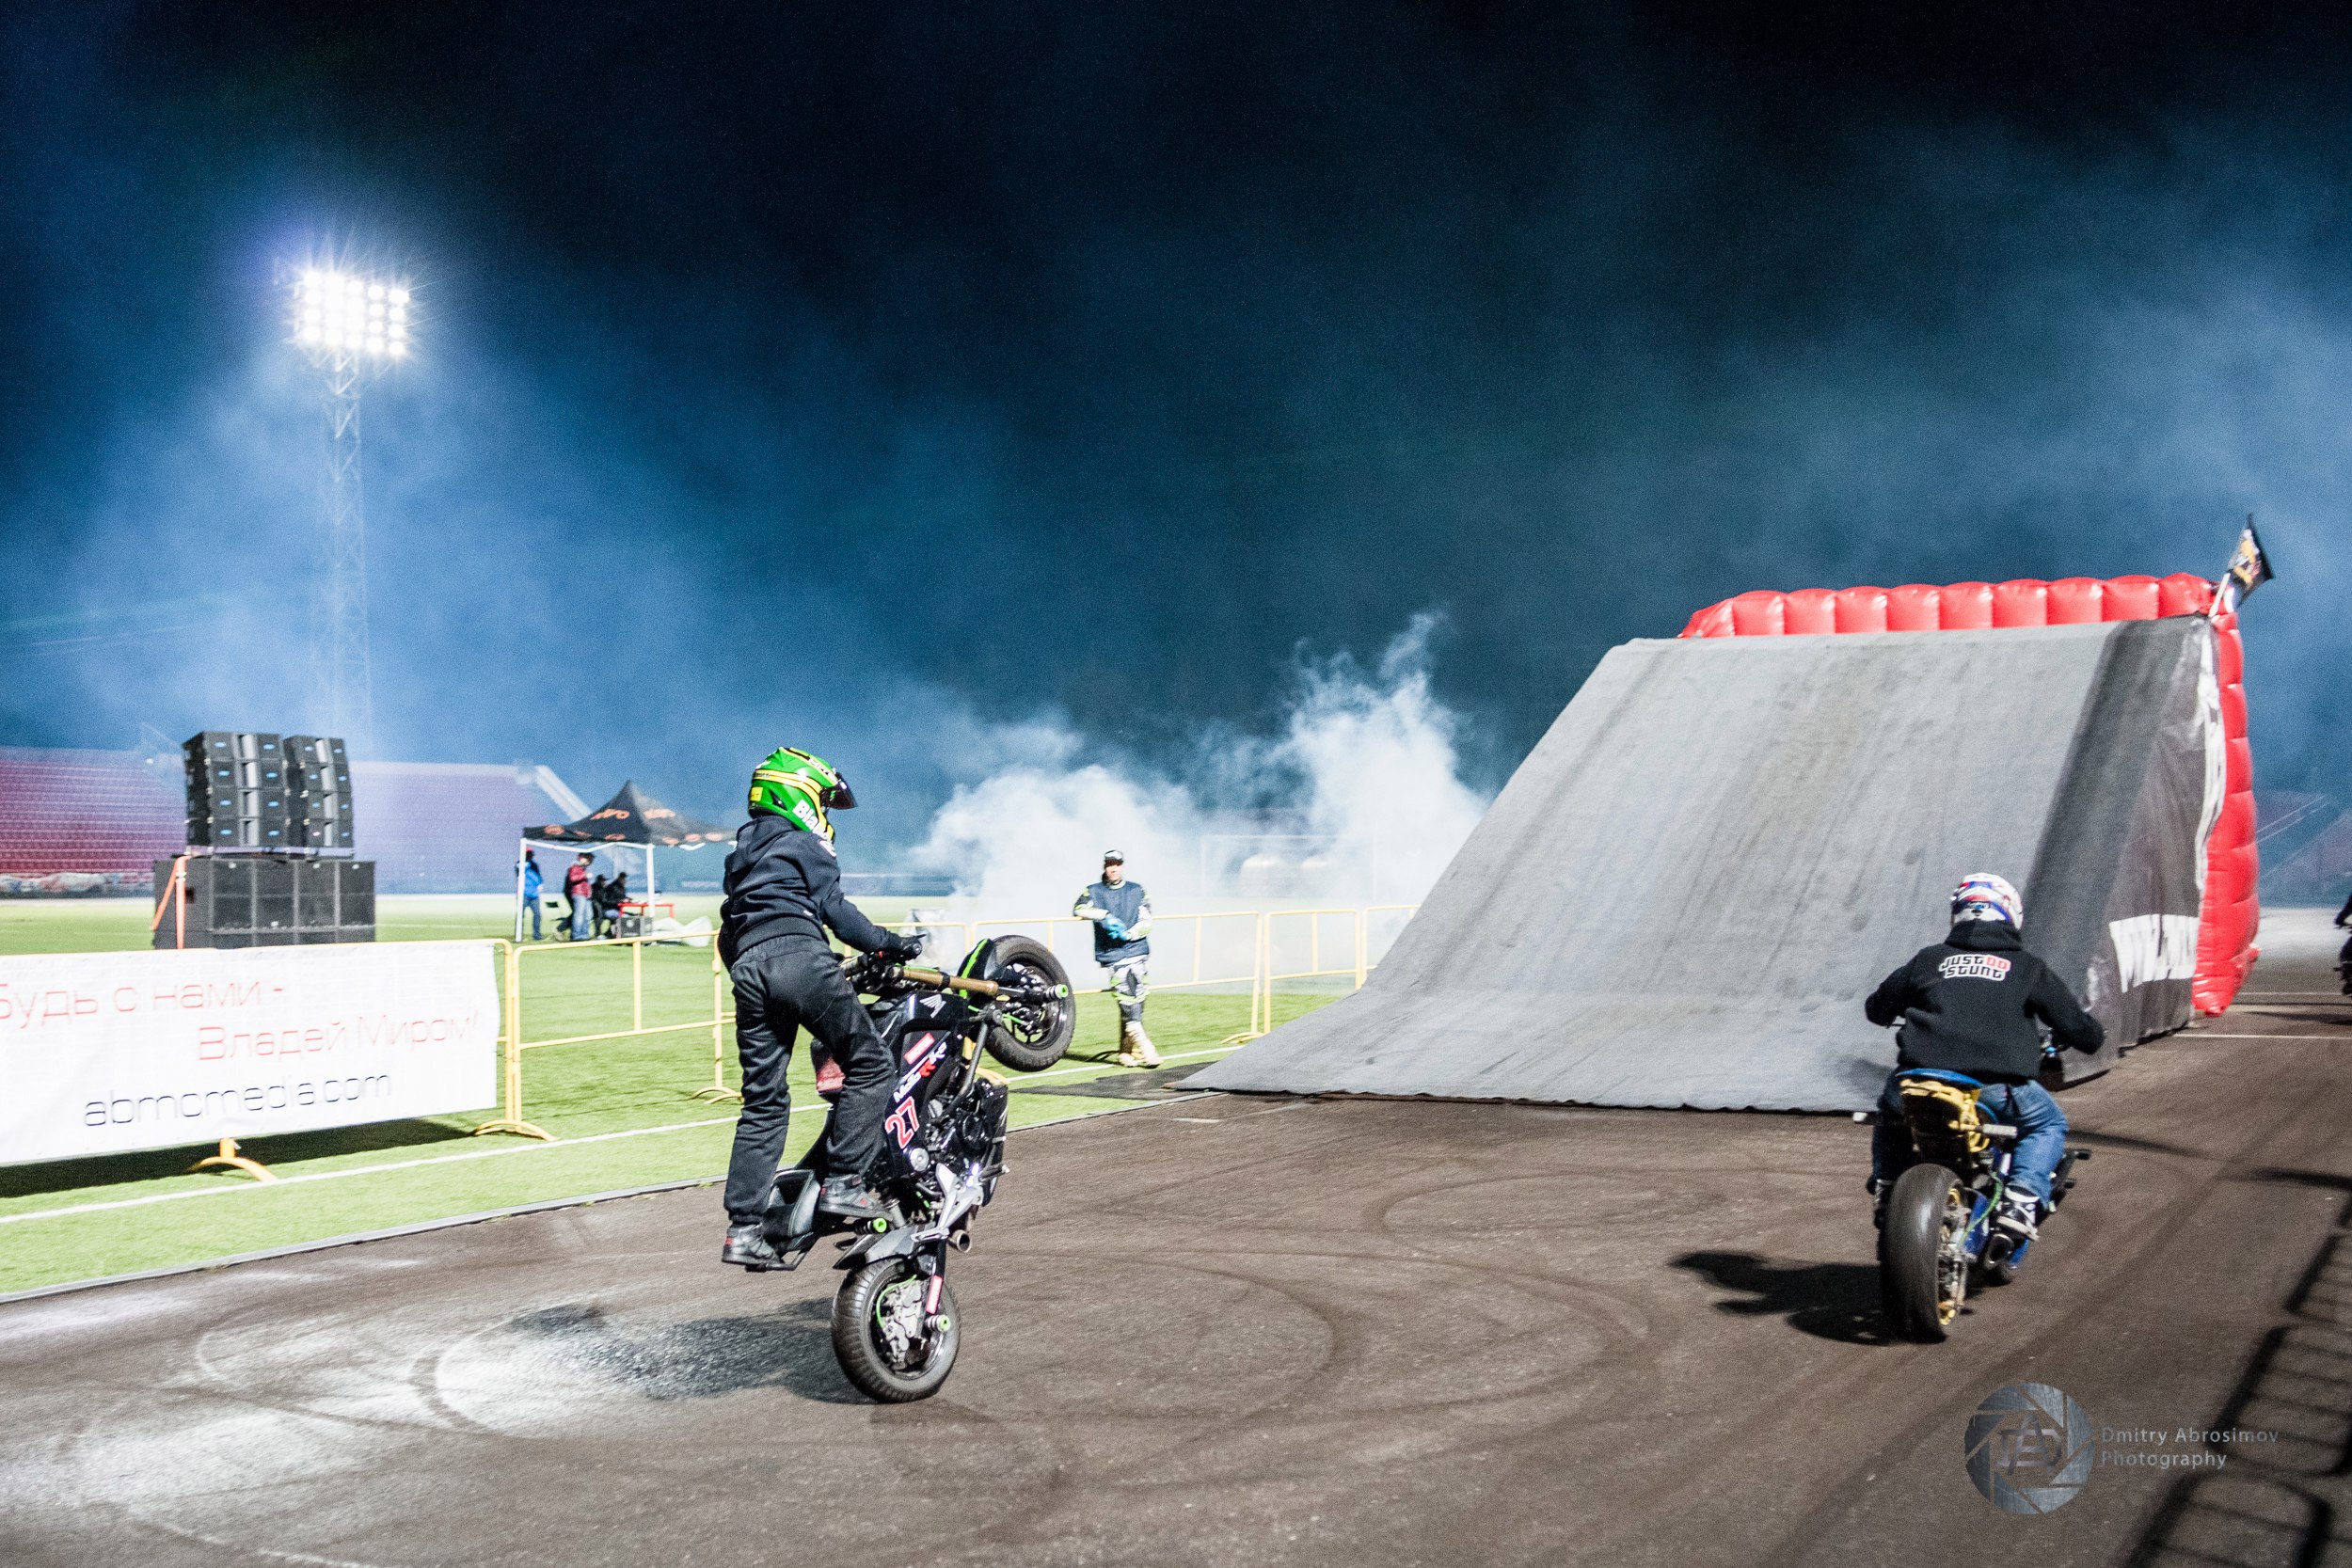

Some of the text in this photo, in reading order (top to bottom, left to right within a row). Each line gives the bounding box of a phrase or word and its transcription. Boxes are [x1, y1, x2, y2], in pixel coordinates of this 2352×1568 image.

[154, 981, 261, 1011] нами
[199, 1019, 346, 1061] Владей
[84, 1074, 392, 1127] abmcmedia.com
[884, 1096, 920, 1149] 27
